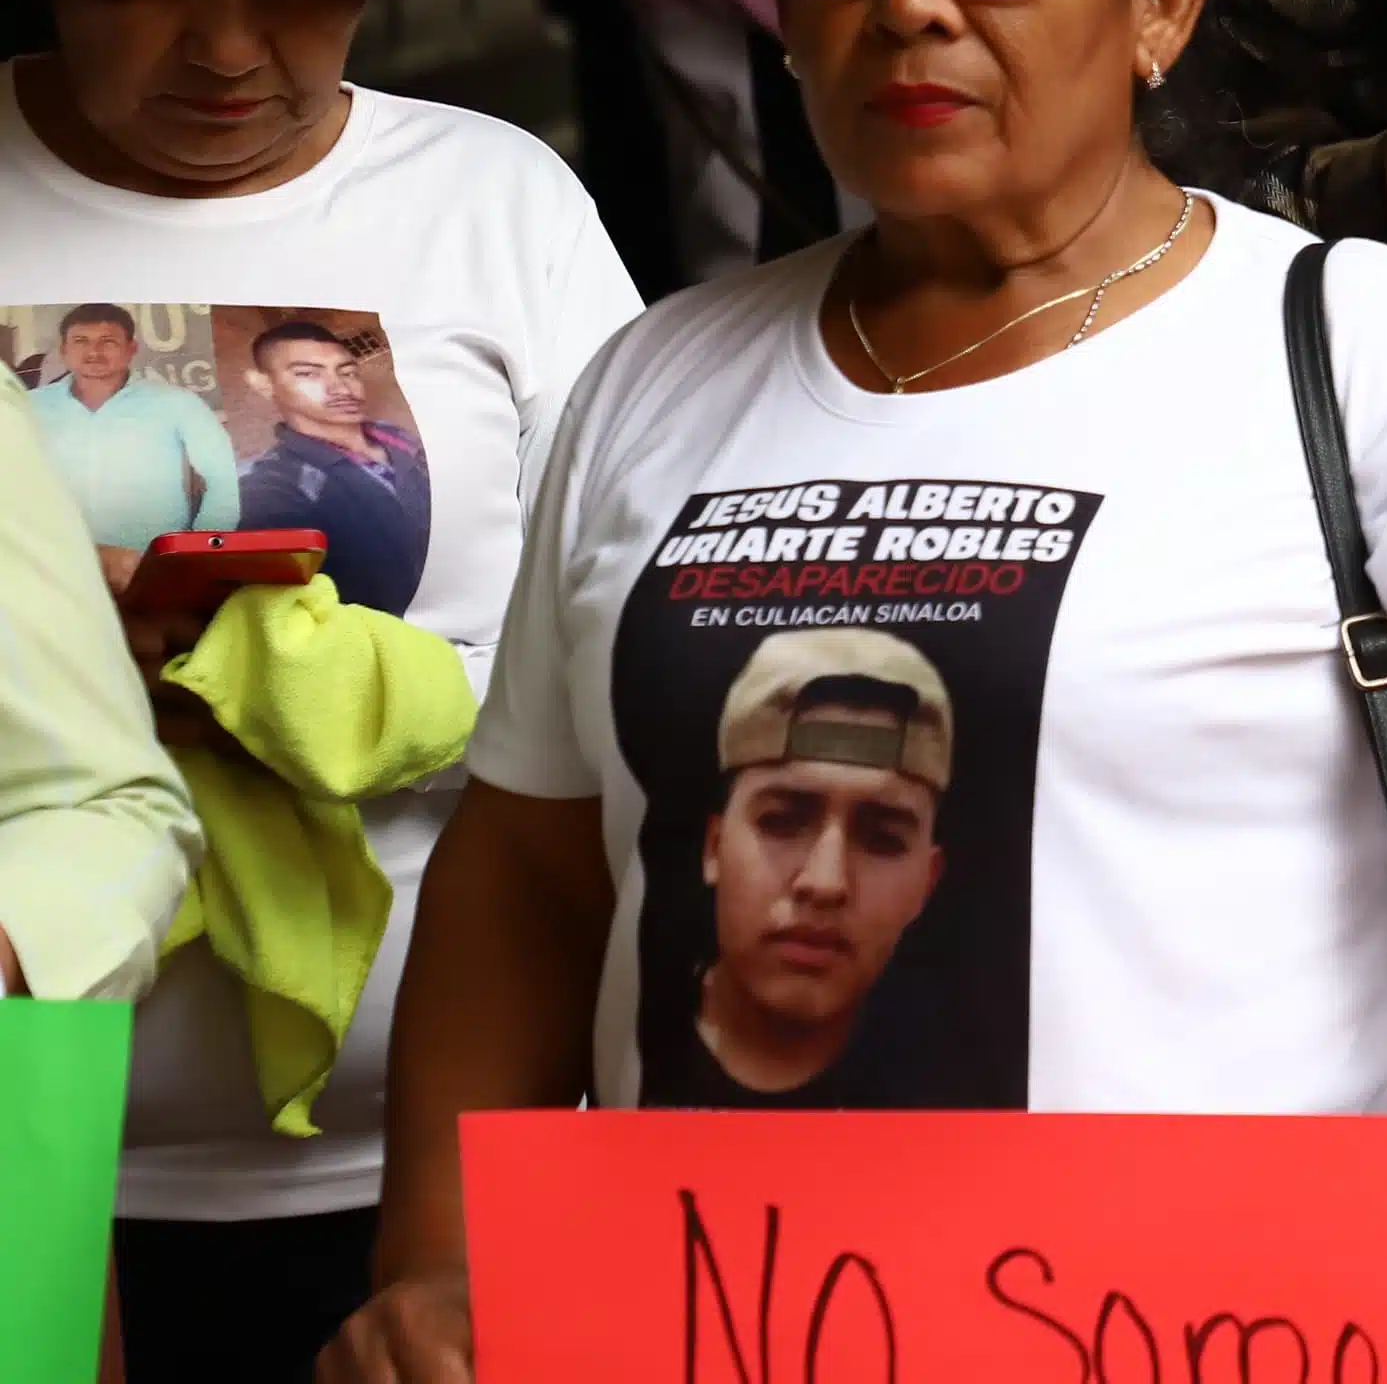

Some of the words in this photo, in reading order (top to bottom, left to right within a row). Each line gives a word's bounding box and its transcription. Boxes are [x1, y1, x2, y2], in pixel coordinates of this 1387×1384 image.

[689, 484, 841, 529] JESUS
[847, 484, 1077, 525] ALBERTO
[655, 526, 866, 567] URIARTE
[872, 528, 1074, 563] ROBLES
[668, 562, 1025, 600] DESAPARECIDO
[690, 608, 727, 627] EN
[734, 601, 869, 626] CULIACÁN
[875, 602, 982, 624] SINALOA
